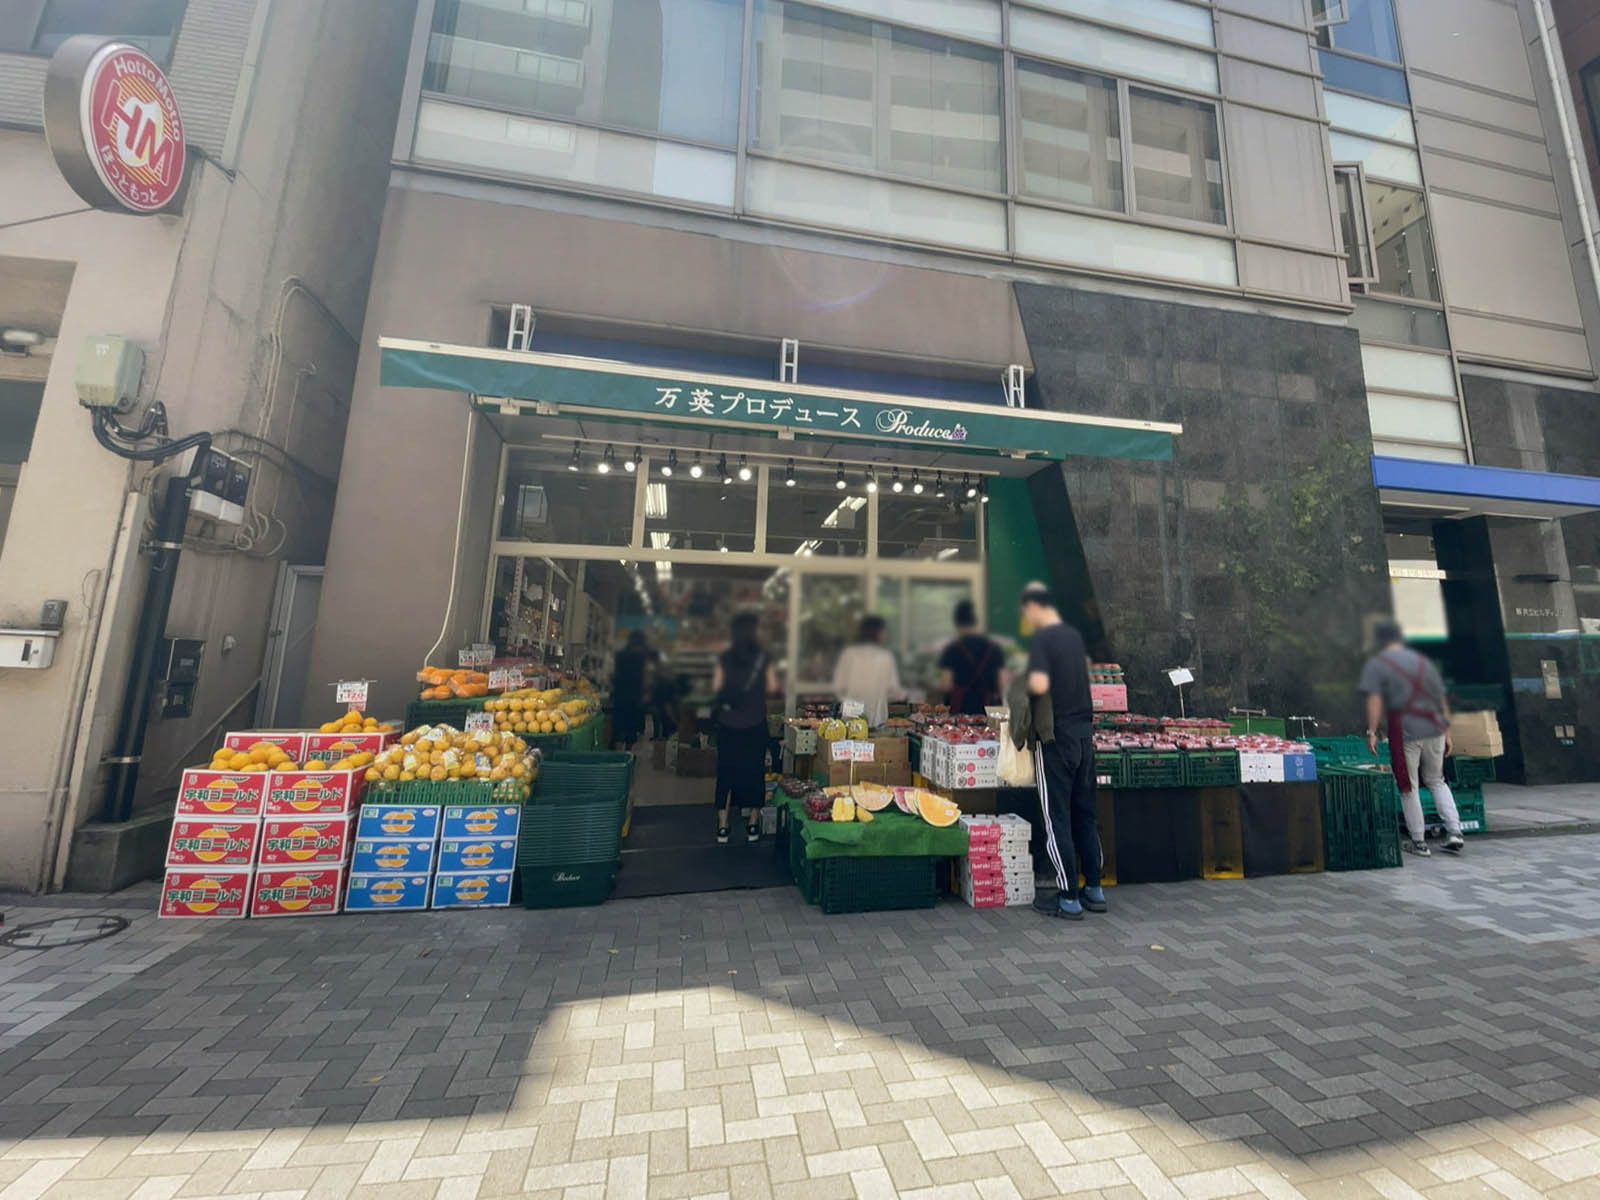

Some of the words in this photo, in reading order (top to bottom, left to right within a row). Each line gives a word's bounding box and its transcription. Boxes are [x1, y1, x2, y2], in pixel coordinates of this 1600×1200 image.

[114, 56, 155, 81] Hotto
[156, 78, 180, 141] Motto
[100, 145, 159, 203] ほっともっと
[655, 386, 861, 428] 万英プロデュース
[875, 408, 951, 440] Produce
